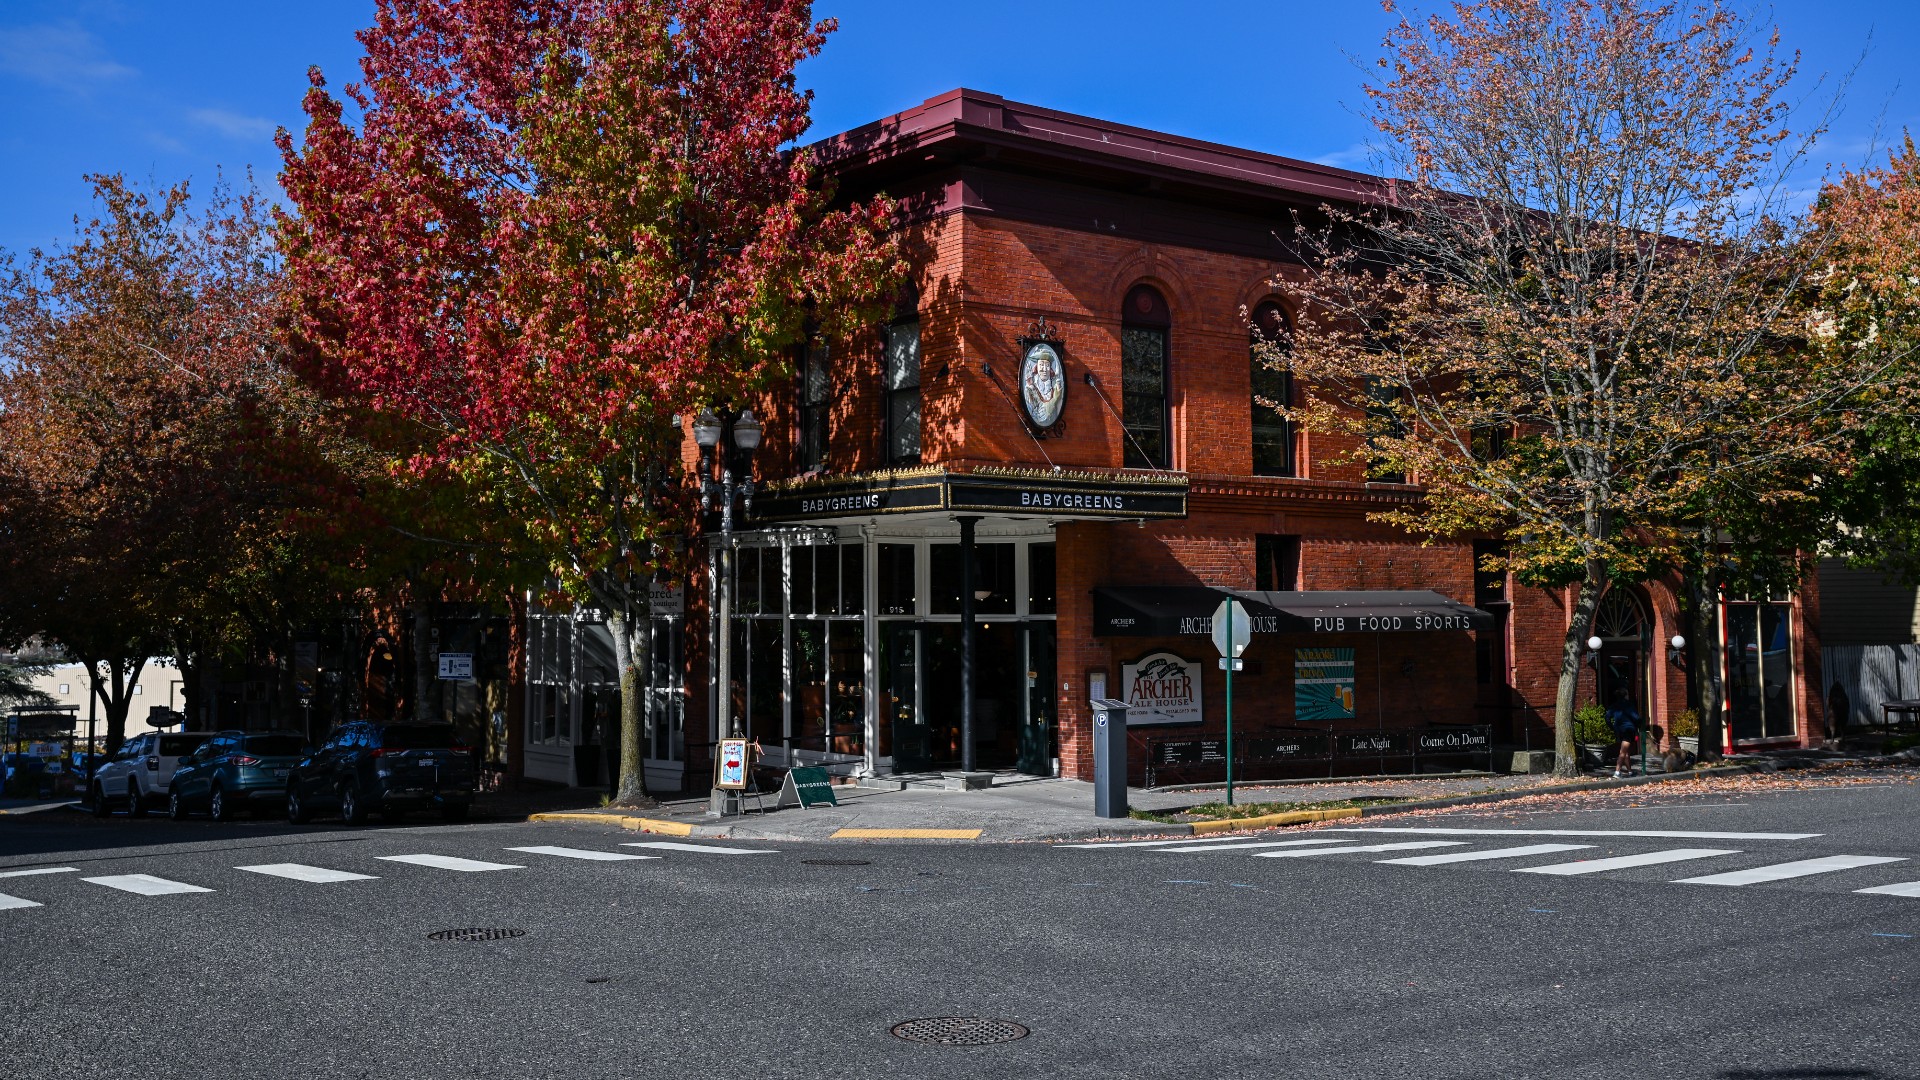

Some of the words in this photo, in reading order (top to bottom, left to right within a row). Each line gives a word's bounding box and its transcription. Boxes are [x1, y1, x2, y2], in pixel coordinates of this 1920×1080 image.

[802, 494, 879, 512] BABYGREENS
[1021, 492, 1123, 509] BABYGREENS
[648, 588, 673, 599] ored
[889, 606, 905, 614] 915
[1179, 616, 1212, 634] ARCHE
[1314, 617, 1345, 632] PUB
[1359, 616, 1402, 631] FOOD
[1415, 616, 1470, 630] SPORTS
[1129, 675, 1194, 703] ARCHER
[1133, 700, 1152, 708] ALE
[1156, 699, 1189, 707] HOUSE
[1351, 738, 1368, 750] Late
[1369, 737, 1391, 751] Night
[1420, 735, 1445, 747] Come
[1446, 733, 1460, 746] On
[1461, 733, 1486, 745] Down
[795, 781, 831, 789] BABYGREENS
